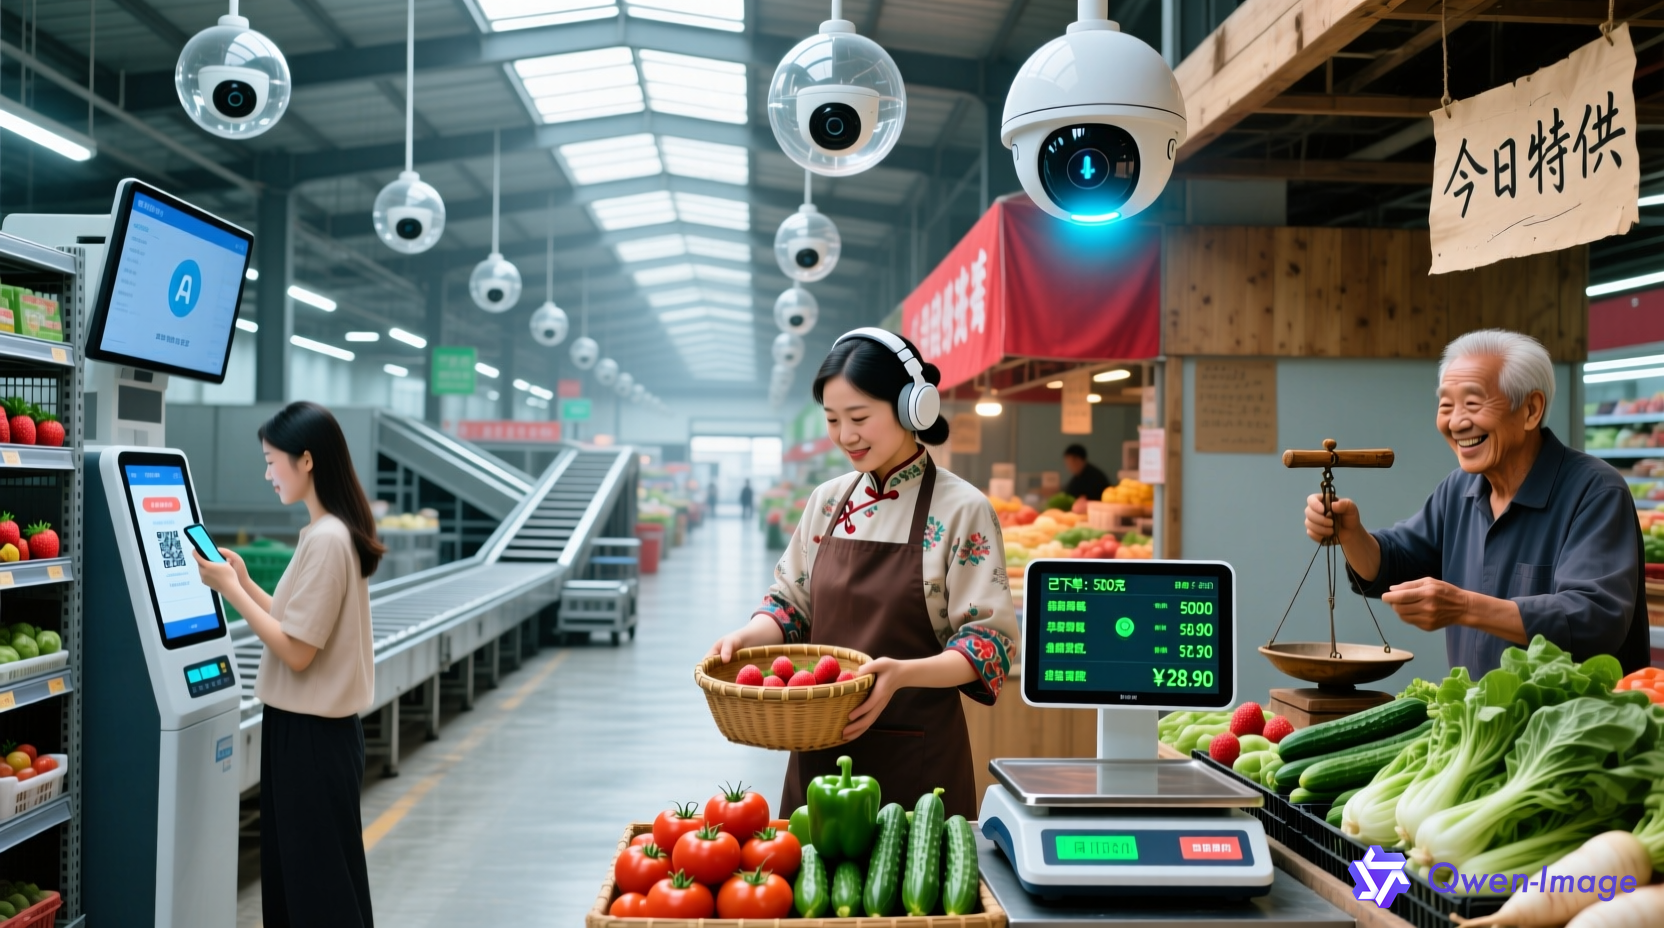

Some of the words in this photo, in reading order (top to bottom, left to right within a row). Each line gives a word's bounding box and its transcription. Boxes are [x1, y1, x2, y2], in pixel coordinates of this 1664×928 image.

[1443, 90, 1626, 219] 今日特供
[174, 274, 193, 305] A
[1180, 601, 1213, 615] 5000
[1152, 667, 1214, 688] ¥28.90
